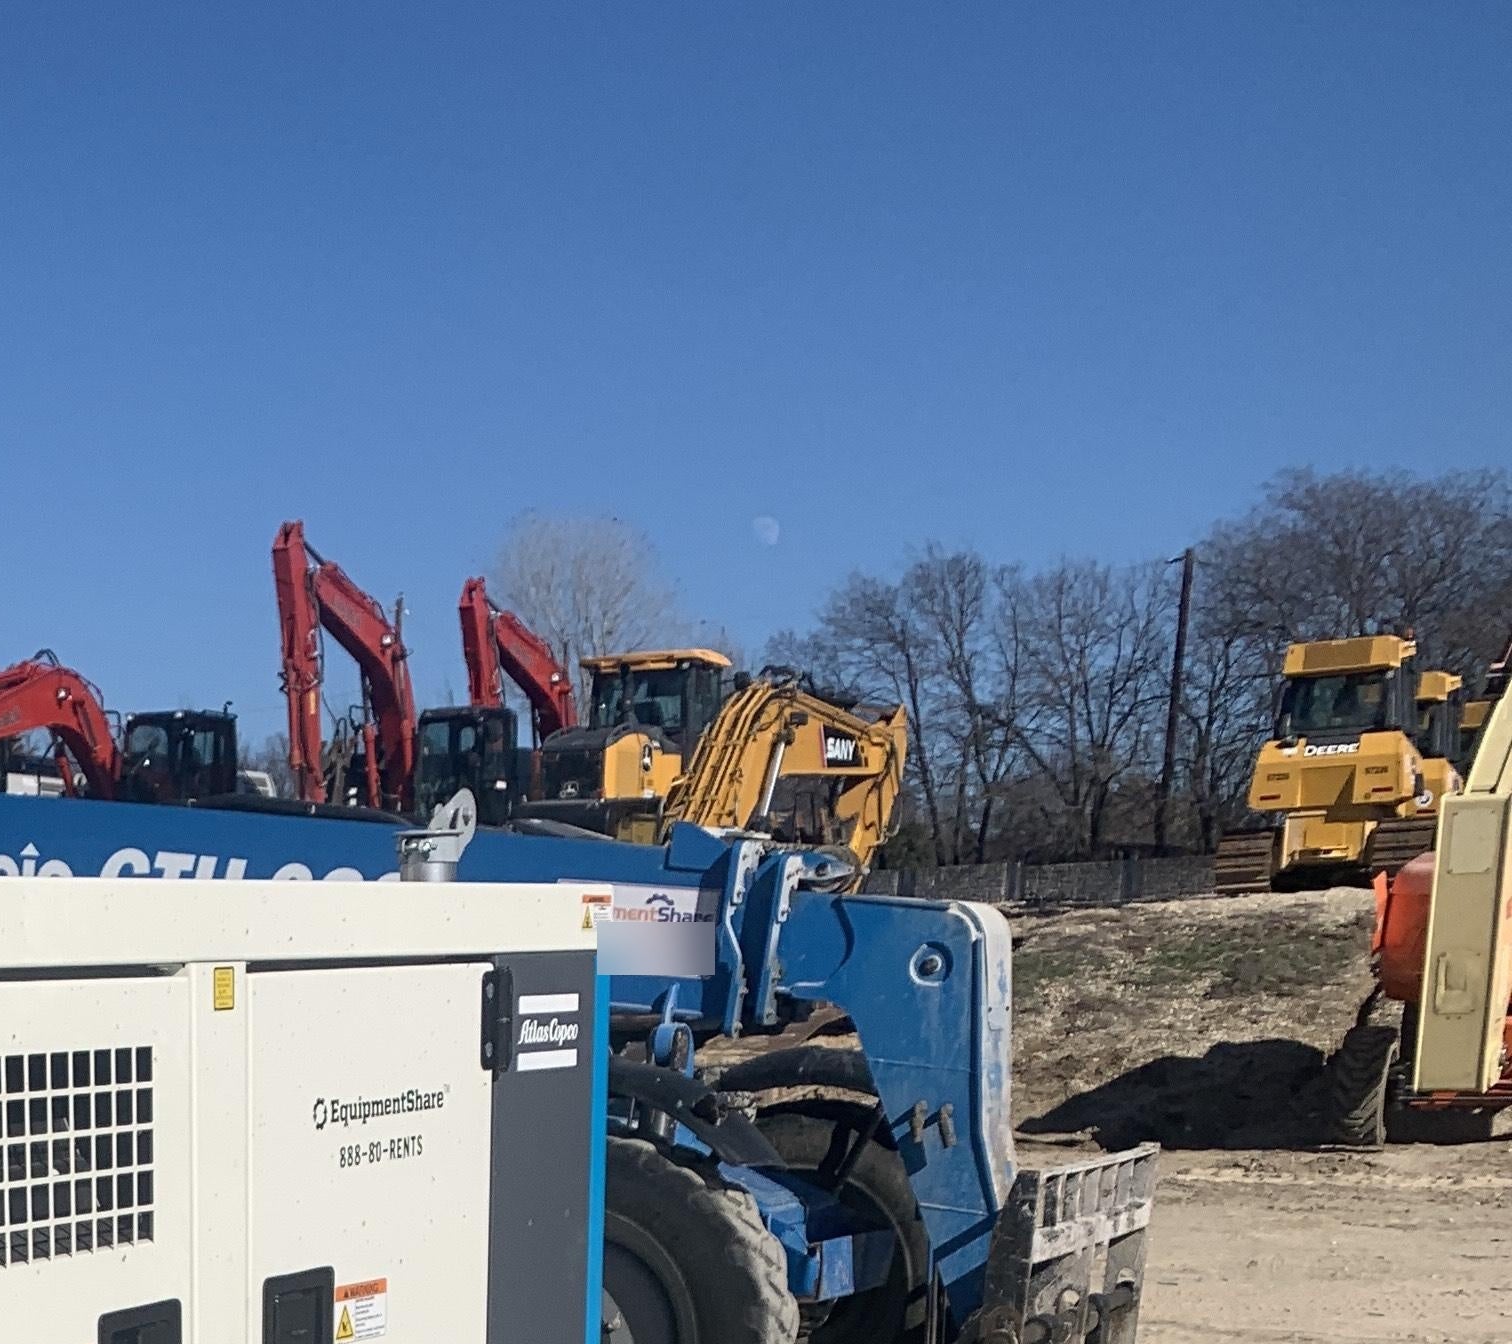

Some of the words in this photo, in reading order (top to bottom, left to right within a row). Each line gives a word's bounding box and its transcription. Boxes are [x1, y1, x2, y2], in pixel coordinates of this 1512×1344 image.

[827, 737, 857, 761] SANY
[1303, 743, 1360, 757] DEERE
[517, 1019, 549, 1044] Atlas
[549, 1017, 579, 1046] Copco
[339, 1134, 423, 1168] 888-80-RENTS
